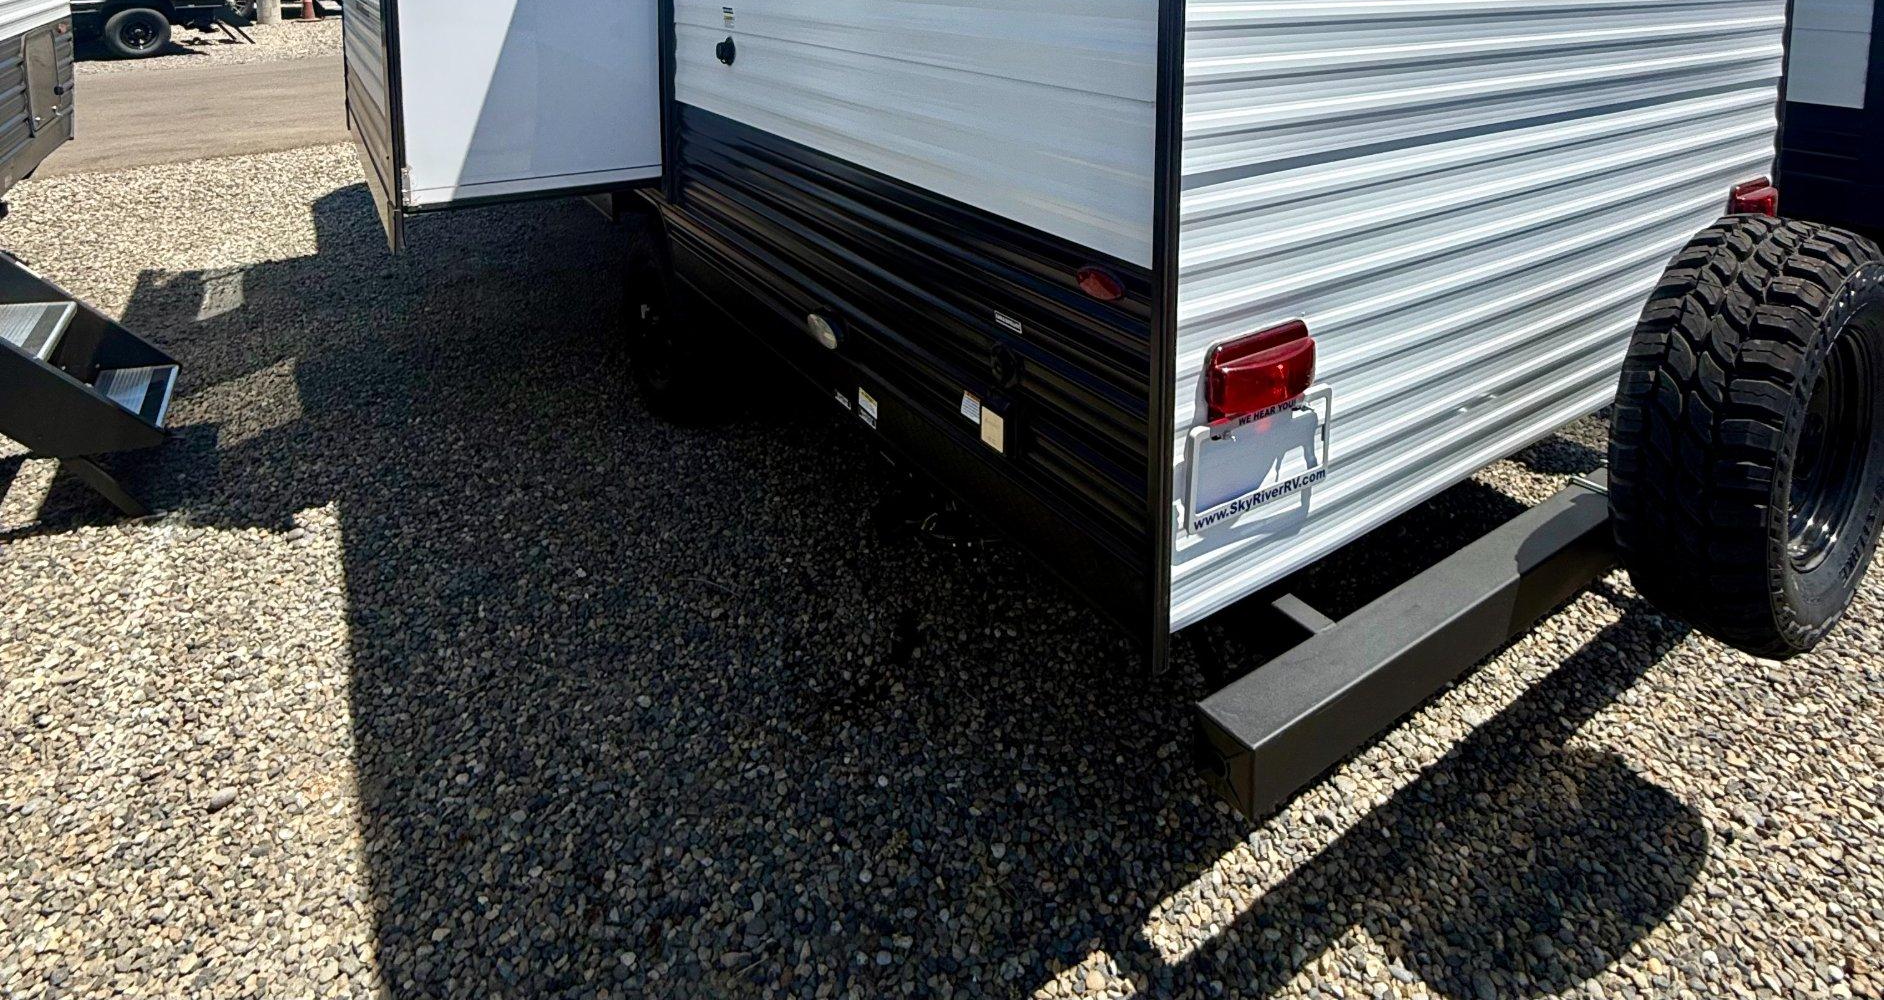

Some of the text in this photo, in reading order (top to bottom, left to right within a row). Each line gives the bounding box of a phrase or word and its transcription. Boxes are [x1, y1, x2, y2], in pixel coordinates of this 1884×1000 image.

[1238, 414, 1252, 426] WE
[1253, 406, 1276, 421] HEAR
[1193, 469, 1326, 530] www.SkyRiverRV.com
